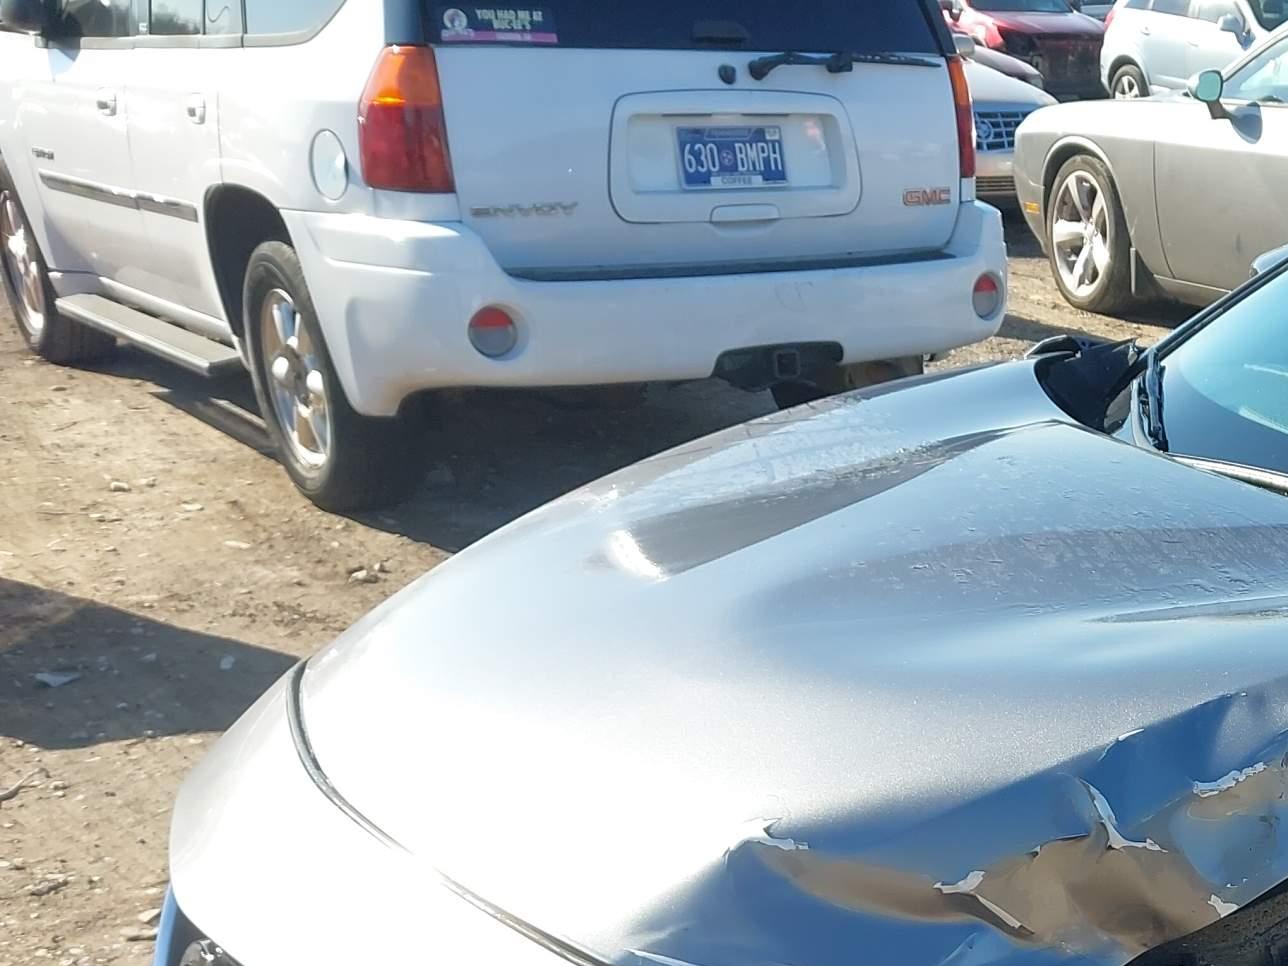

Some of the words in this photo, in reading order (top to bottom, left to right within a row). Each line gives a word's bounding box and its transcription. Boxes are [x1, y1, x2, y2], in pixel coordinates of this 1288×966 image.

[684, 143, 719, 173] 630
[735, 142, 782, 171] BMPH
[903, 188, 951, 206] GMC
[470, 201, 578, 218] ENVOY
